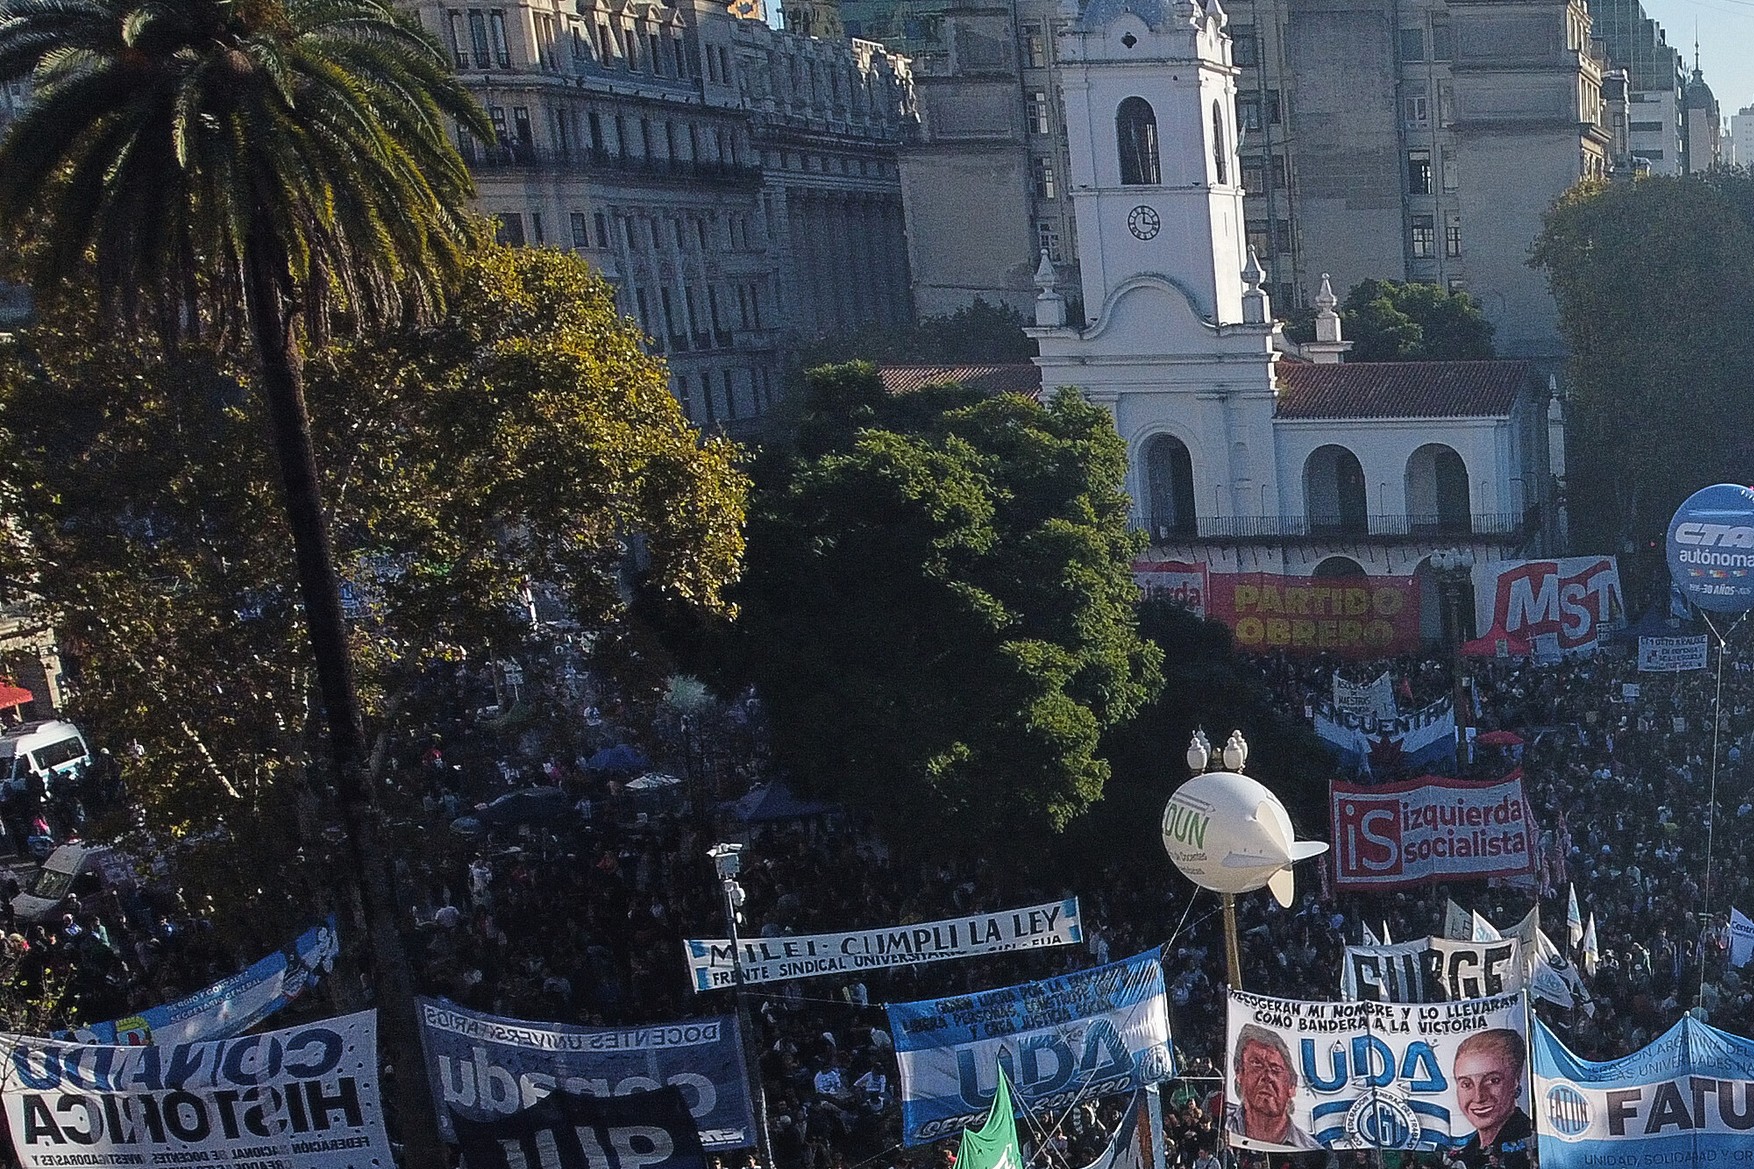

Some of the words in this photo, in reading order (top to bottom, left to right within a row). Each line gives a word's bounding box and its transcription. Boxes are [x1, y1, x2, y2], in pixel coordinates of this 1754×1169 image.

[1675, 522, 1754, 548] CTA
[1235, 584, 1402, 617] PARTIDO
[1506, 571, 1622, 640] MST
[1236, 616, 1395, 647] OBRERO
[1403, 794, 1524, 829] izquierda
[1404, 830, 1526, 864] socialista
[840, 923, 958, 957] CUMPLI
[969, 918, 1001, 946] LA
[1013, 905, 1061, 936] LEY
[712, 967, 770, 987] FRENTE
[778, 955, 847, 977] SINDICAL
[1254, 1010, 1293, 1030] COMO
[1299, 1016, 1368, 1032] BANDERA
[1373, 1018, 1386, 1032] A
[1391, 1018, 1411, 1034] LA
[1418, 1015, 1489, 1035] VICTORIA
[1307, 1004, 1325, 1019] MI
[1333, 1003, 1395, 1019] NOMBRE
[1401, 1006, 1412, 1020] Y
[1419, 1005, 1440, 1021] LO
[956, 1019, 1137, 1110] UDA
[1300, 1034, 1449, 1094] UDA
[1583, 1153, 1643, 1168] UNIDAD,
